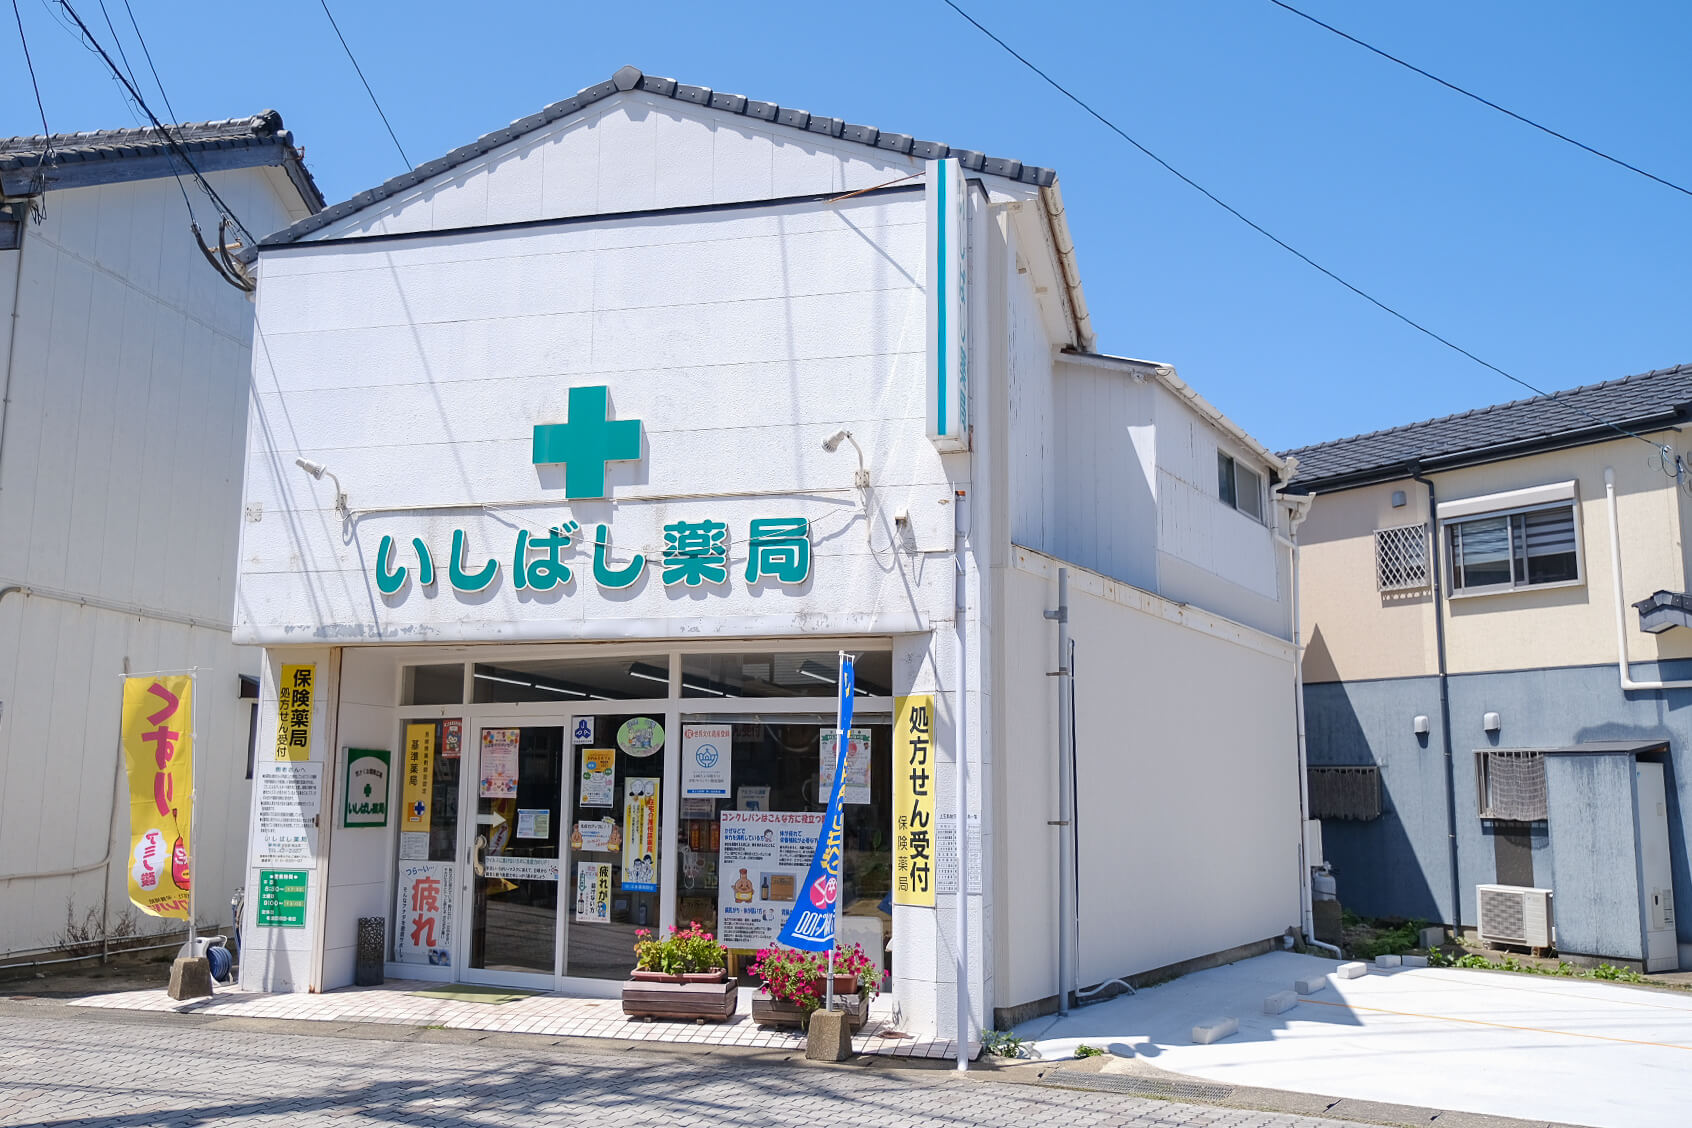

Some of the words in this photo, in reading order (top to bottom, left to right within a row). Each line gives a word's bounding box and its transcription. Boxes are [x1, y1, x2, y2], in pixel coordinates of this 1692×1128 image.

[375, 518, 812, 595] いしばし薬局
[276, 687, 291, 758] 処方せん受付
[288, 668, 312, 748] 保険薬局
[409, 740, 420, 786] 基準薬局
[348, 802, 385, 815] いしばし薬局
[908, 705, 930, 893] 処方せん受付
[598, 865, 609, 901] 疲れが
[897, 816, 909, 892] 保険薬局
[410, 876, 441, 947] 疲れ
